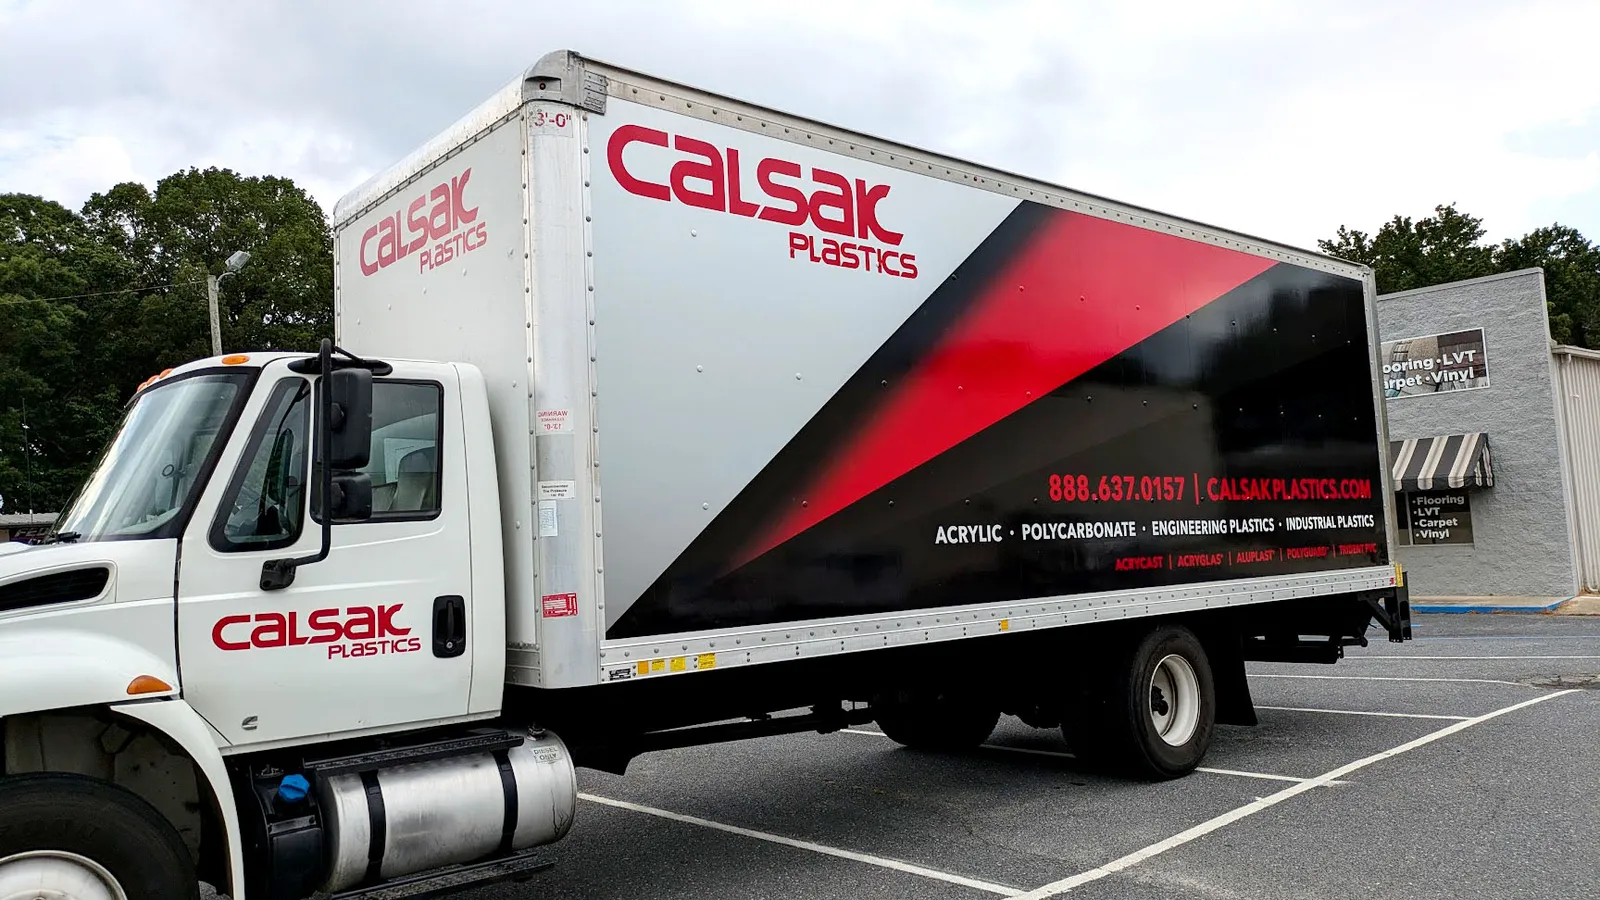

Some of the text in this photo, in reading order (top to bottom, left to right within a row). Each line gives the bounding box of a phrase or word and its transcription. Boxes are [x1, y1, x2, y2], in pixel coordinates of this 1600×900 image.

[1382, 349, 1476, 374] ooring LVT
[1383, 366, 1474, 390] arpet Vinyl
[1049, 474, 1372, 501] 888.637.0157 CALSAKPLASTICS.COM
[1416, 495, 1465, 505] Flooring
[1417, 507, 1440, 516] LVT
[934, 514, 1374, 544] ACRYLIC POLYCARBONATE ENGINEERING PLASTICS INDUSTRIAL PLASTICS
[1419, 517, 1458, 528] Carpet
[1420, 529, 1449, 539] Vinyl
